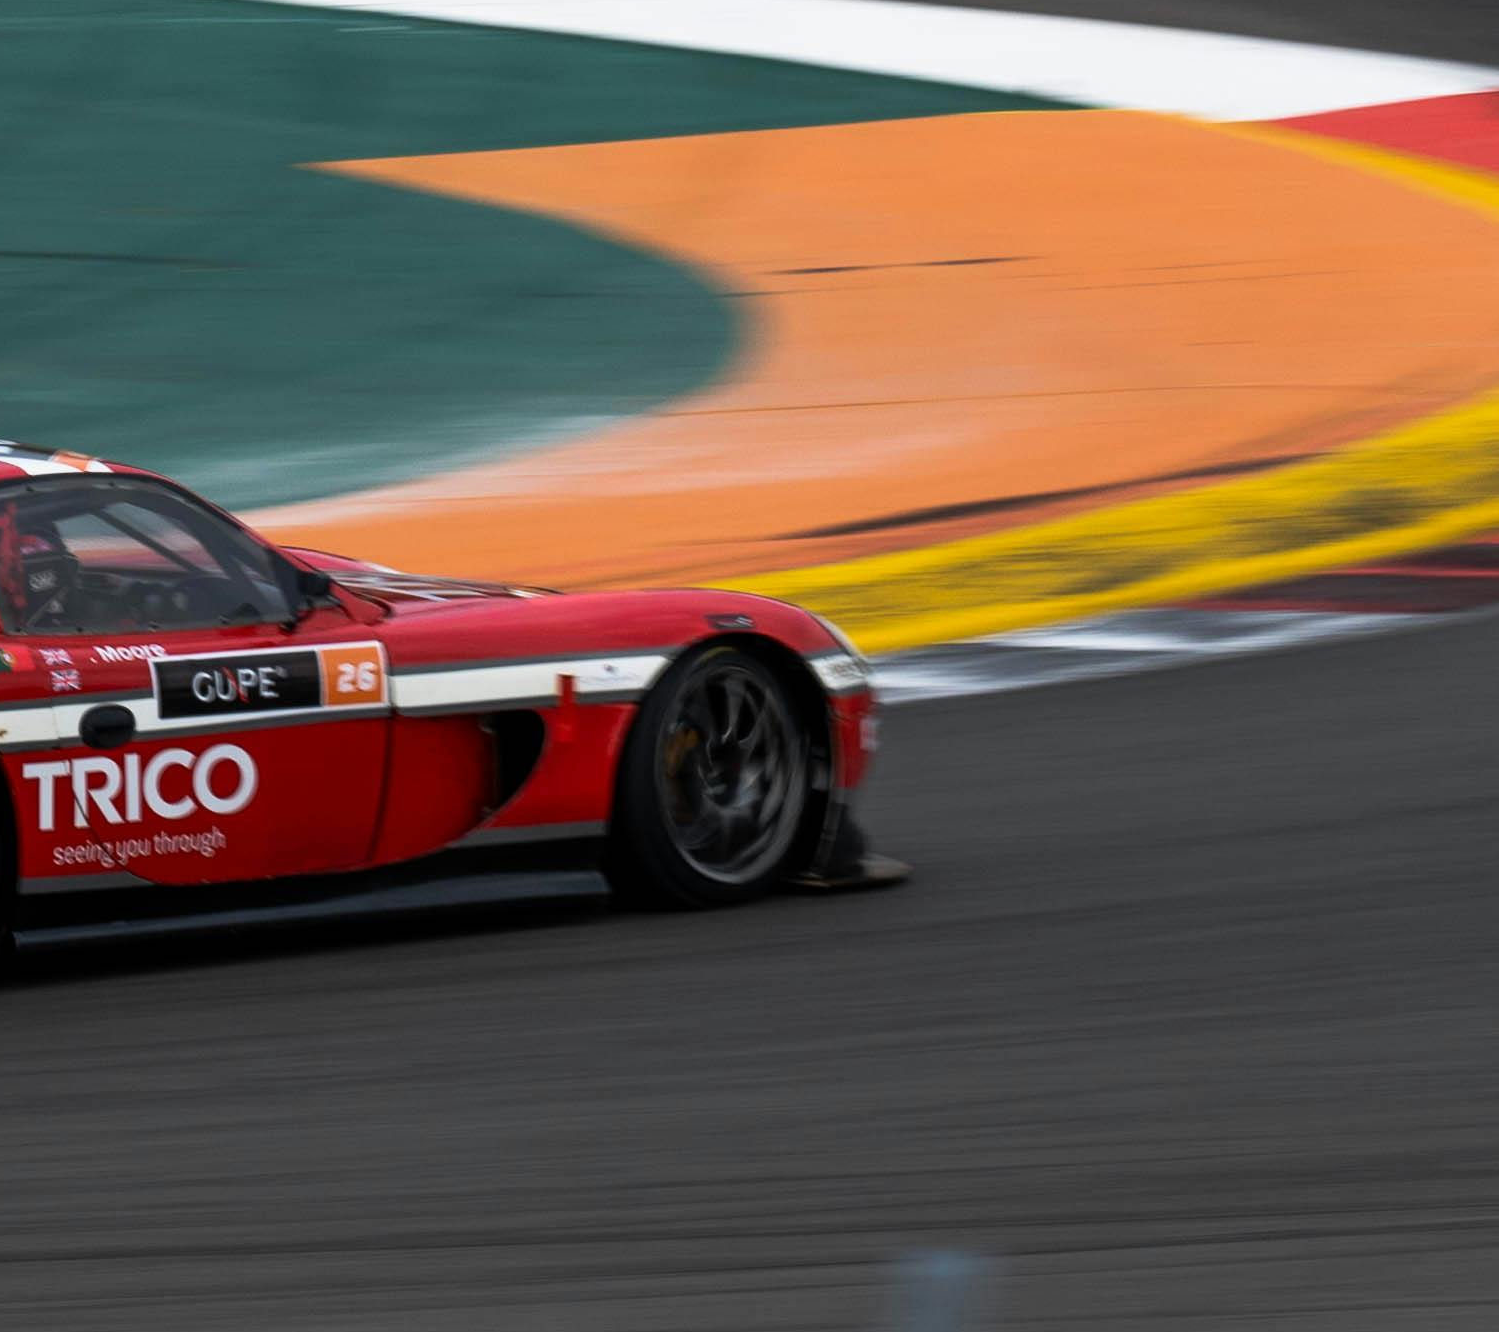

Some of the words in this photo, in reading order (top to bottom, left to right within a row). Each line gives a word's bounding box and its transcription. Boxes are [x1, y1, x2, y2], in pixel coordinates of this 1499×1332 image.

[336, 661, 378, 693] 26
[22, 743, 259, 831] TRICO
[53, 839, 115, 868] seeing
[116, 838, 150, 866] you
[152, 825, 227, 858] through
